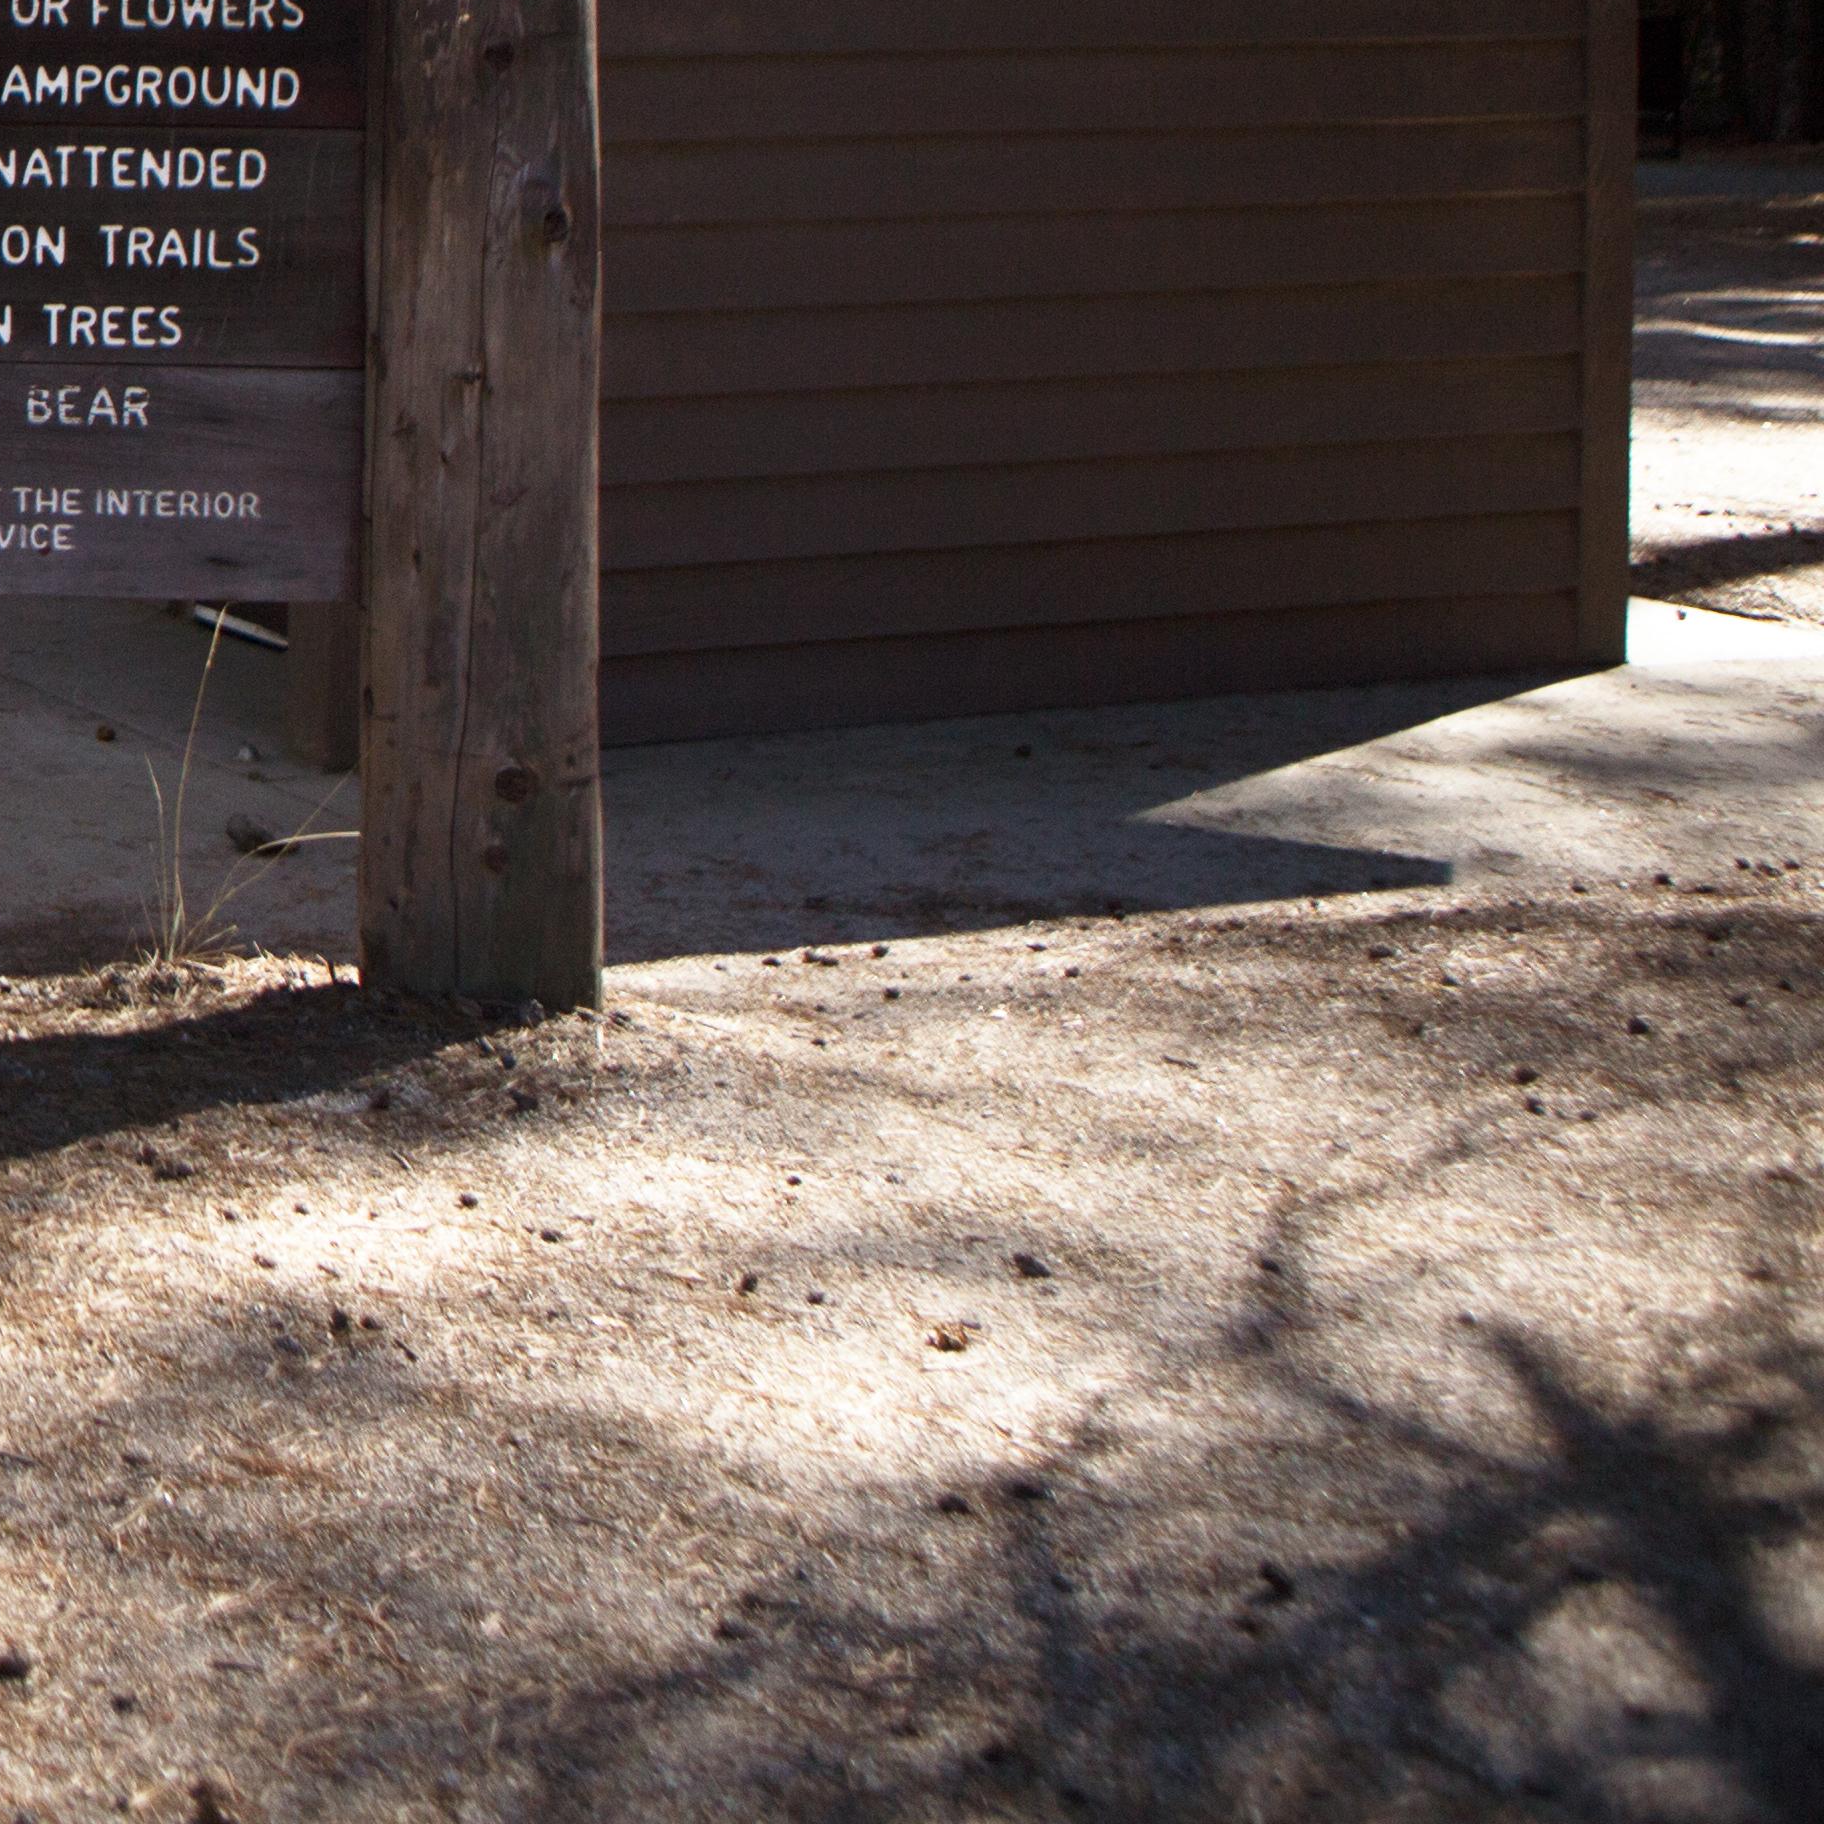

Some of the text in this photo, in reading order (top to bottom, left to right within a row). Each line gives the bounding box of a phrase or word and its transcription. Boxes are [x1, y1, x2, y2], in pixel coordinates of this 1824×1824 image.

[2, 226, 65, 264] ON
[101, 225, 259, 268] TRAILS
[44, 304, 181, 347] TREES
[27, 386, 148, 425] BEAR
[14, 487, 81, 515] THE
[96, 490, 259, 518] INTERIOR
